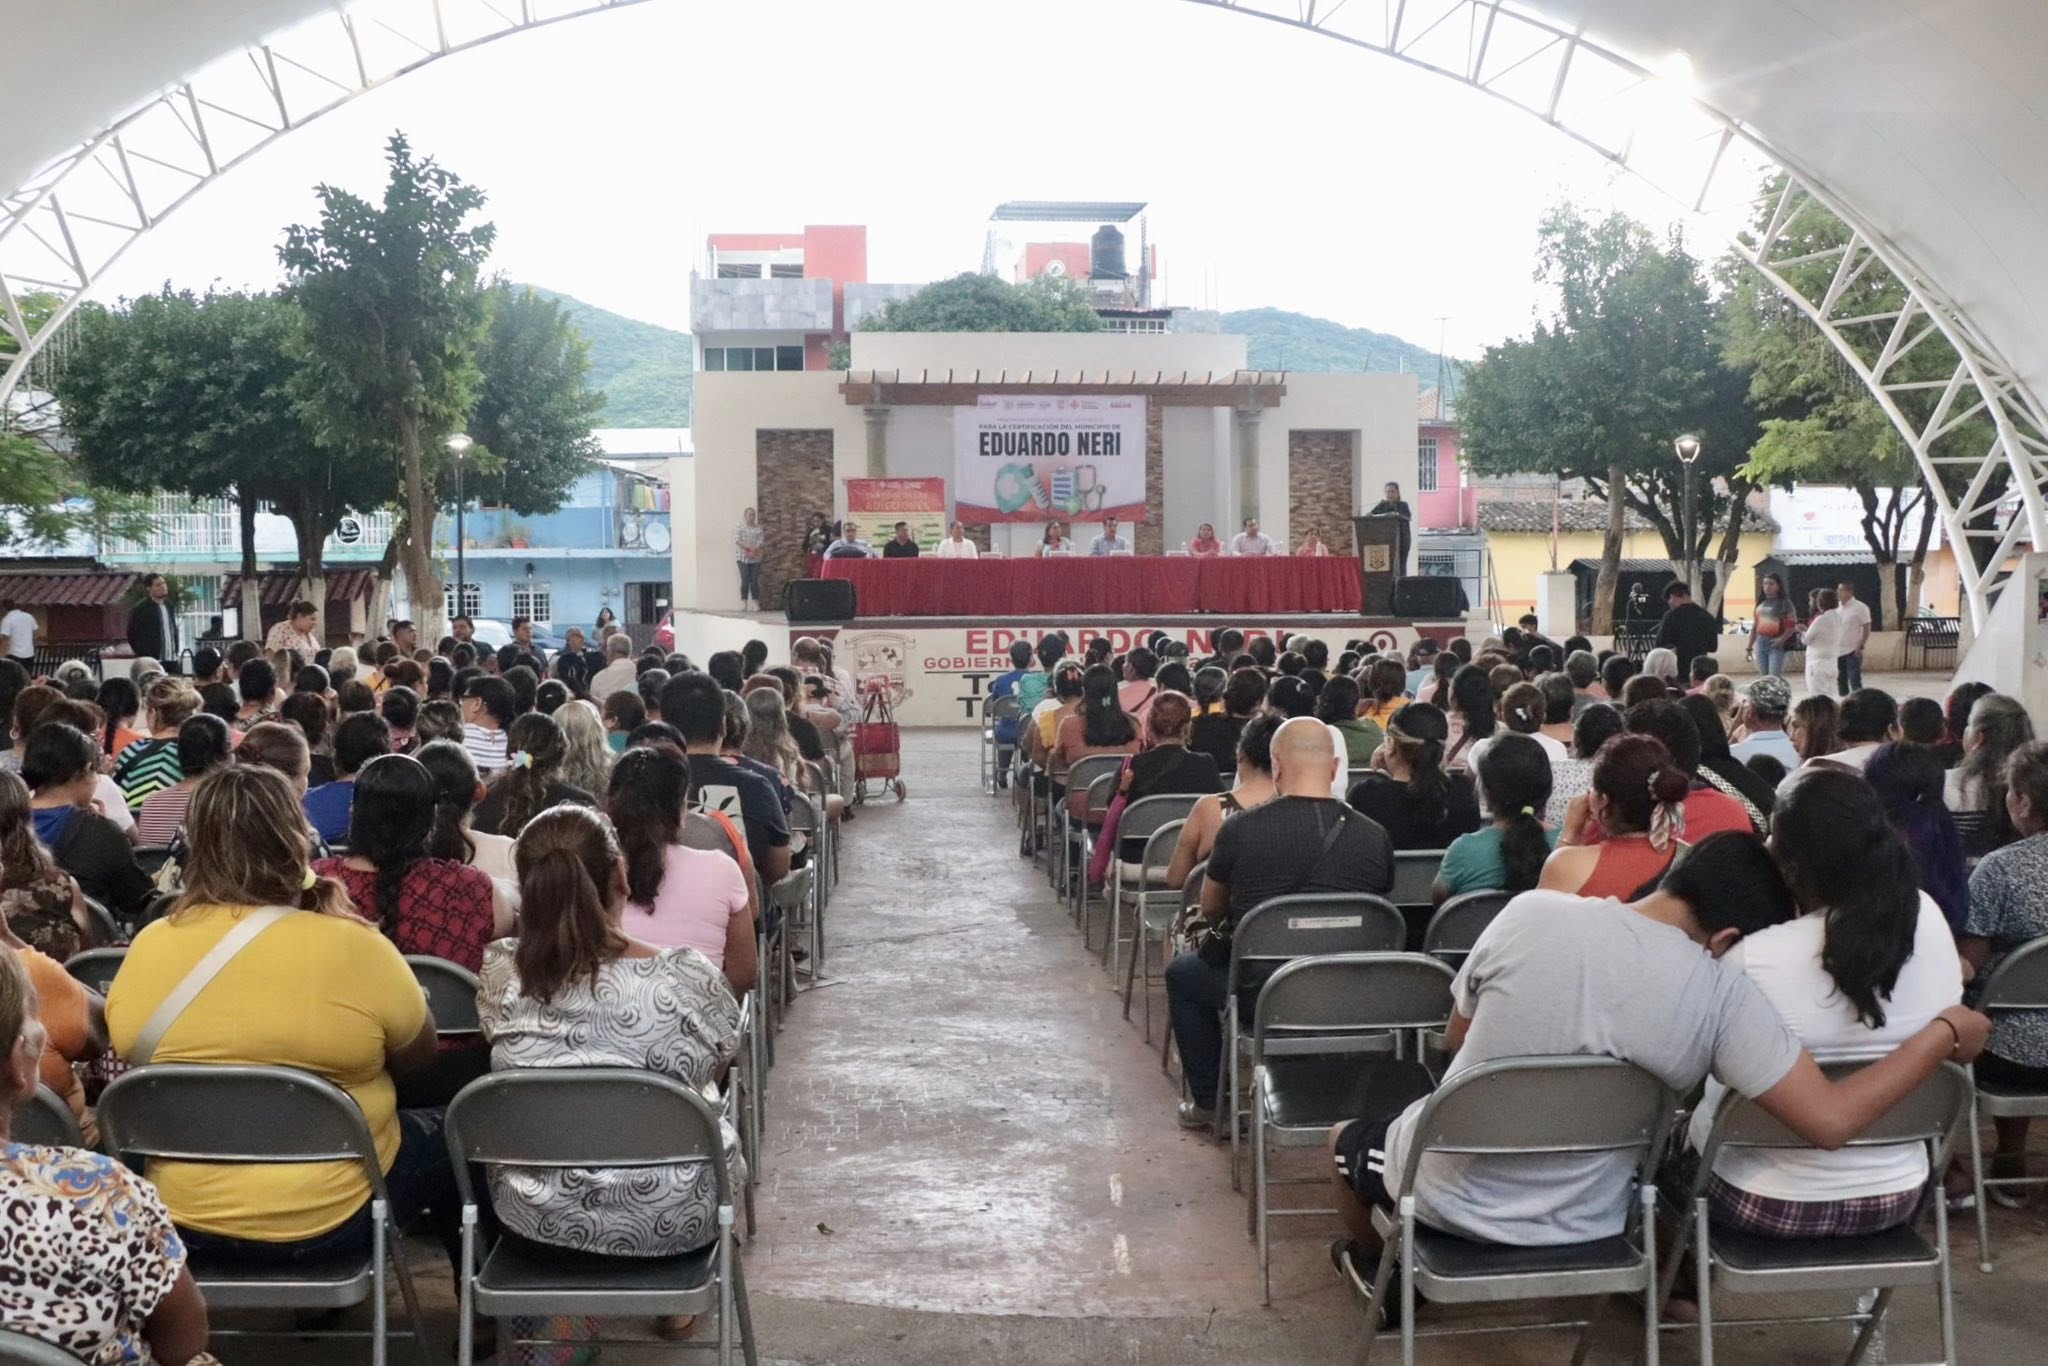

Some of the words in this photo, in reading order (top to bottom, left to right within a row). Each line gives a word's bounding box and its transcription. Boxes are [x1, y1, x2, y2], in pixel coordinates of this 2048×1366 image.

[979, 432, 1070, 456] EDUARDO
[1077, 432, 1121, 456] NERI
[966, 629, 1156, 655] EDRD
[1186, 629, 1284, 654] NRI
[924, 656, 1037, 669] GOBIER
